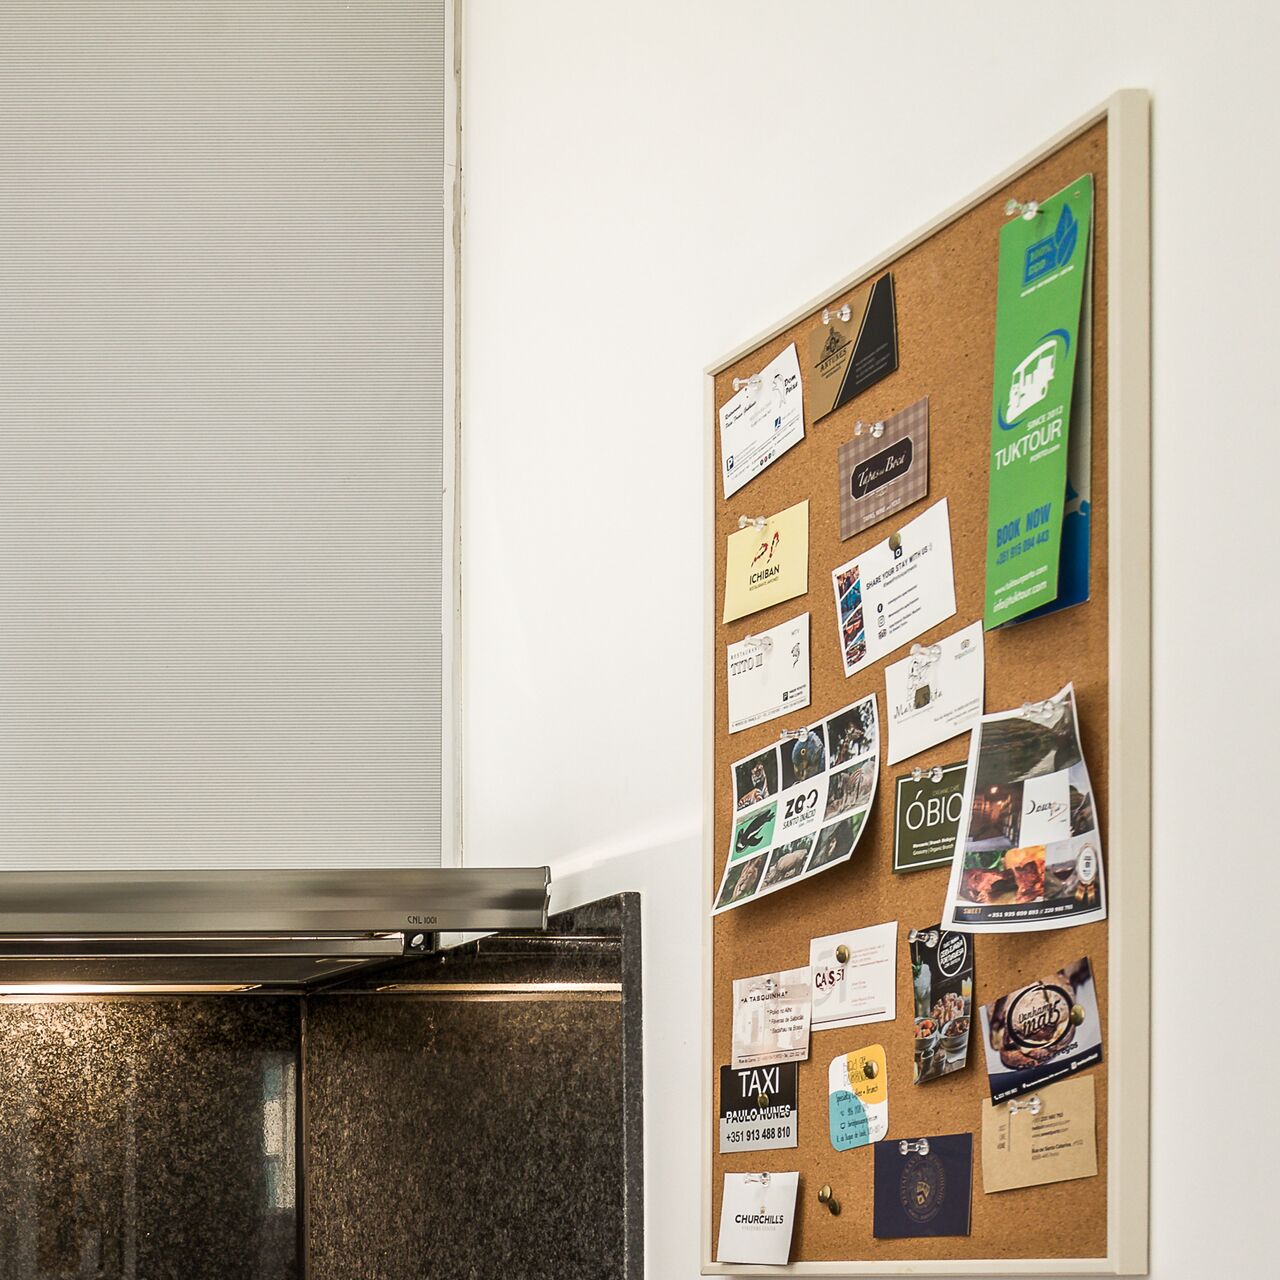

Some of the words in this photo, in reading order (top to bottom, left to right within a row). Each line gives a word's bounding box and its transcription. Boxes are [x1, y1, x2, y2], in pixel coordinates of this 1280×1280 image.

[995, 419, 1062, 470] TUKTOUR
[996, 518, 1020, 548] BOOK
[1026, 502, 1052, 532] NOW
[749, 564, 780, 585] ICHIBAN
[866, 574, 882, 590] SHARE
[882, 567, 895, 579] YOUR
[895, 559, 908, 572] STAY
[909, 551, 921, 563] WITH
[921, 545, 928, 555] US
[785, 789, 818, 819] ZOO
[407, 915, 423, 924] CNL
[738, 1066, 780, 1098] TAXI
[726, 1108, 758, 1124] PAULO
[759, 1104, 791, 1121] NUNES
[726, 1130, 744, 1143] +351
[746, 1129, 760, 1141] 913
[762, 1127, 776, 1140] 488
[777, 1126, 791, 1138] 810
